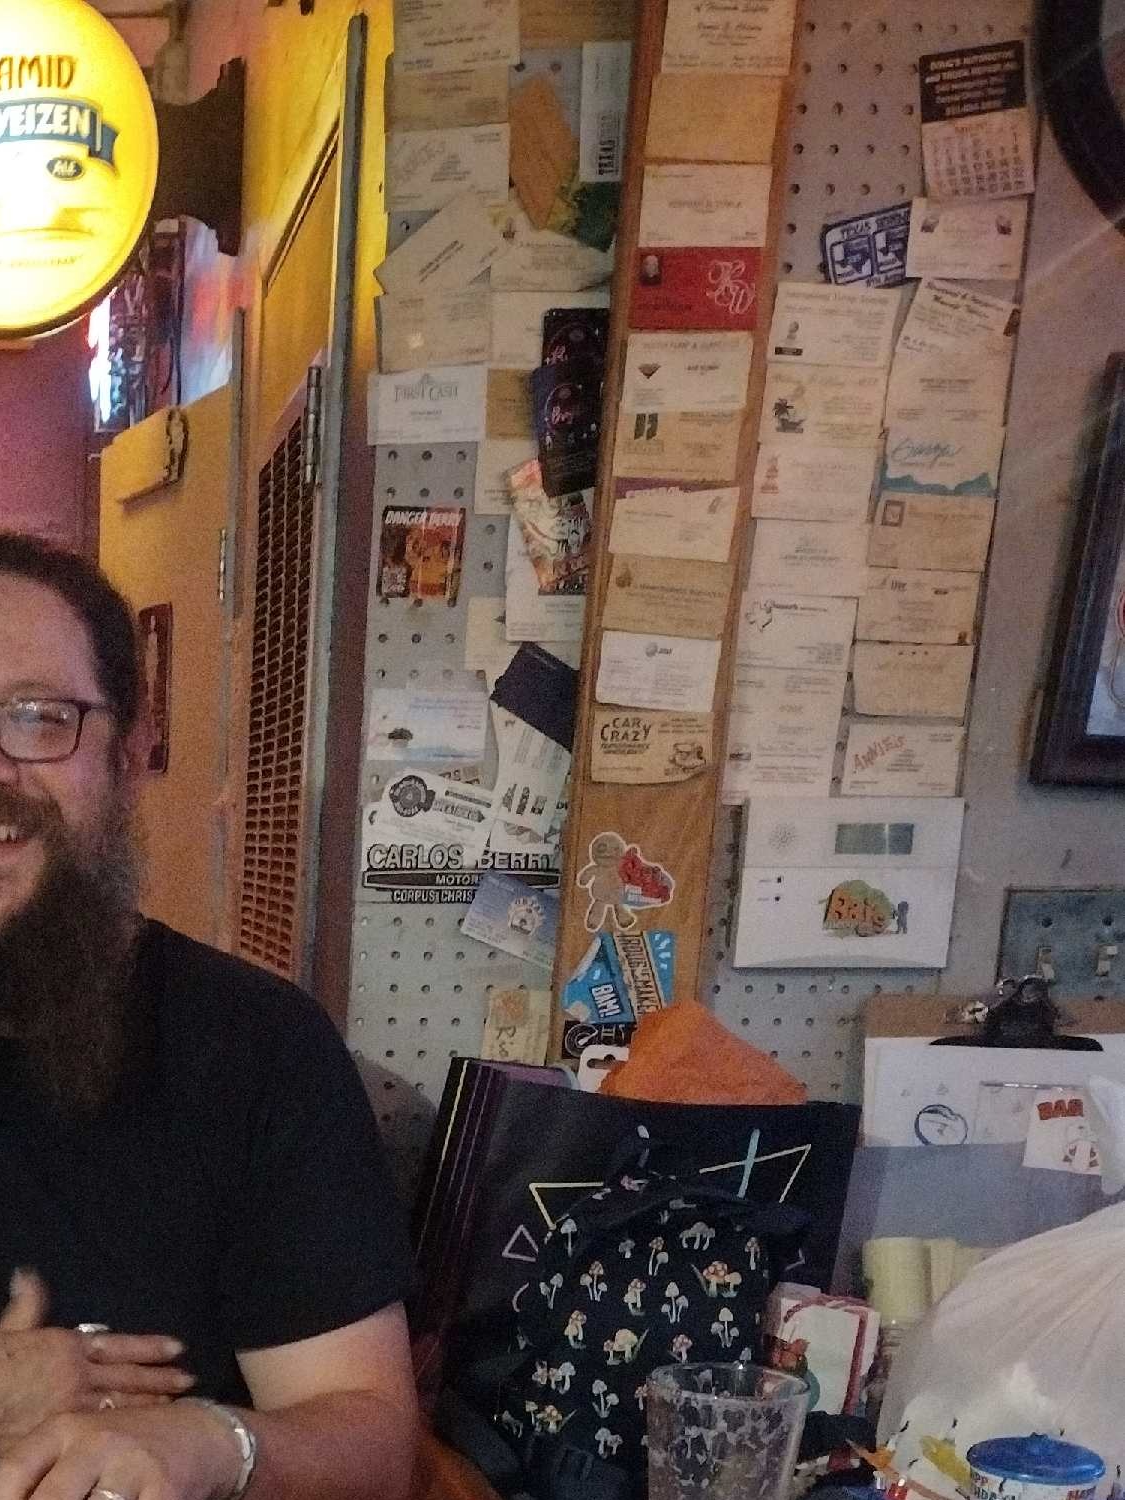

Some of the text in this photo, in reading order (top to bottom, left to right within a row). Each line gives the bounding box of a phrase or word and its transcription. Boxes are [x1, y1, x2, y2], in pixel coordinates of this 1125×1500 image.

[600, 723, 652, 743] CRAZY
[612, 716, 642, 730] CAR
[367, 843, 465, 870] CARLOS
[392, 888, 436, 904] CORPUS
[591, 983, 622, 1019] BAM!
